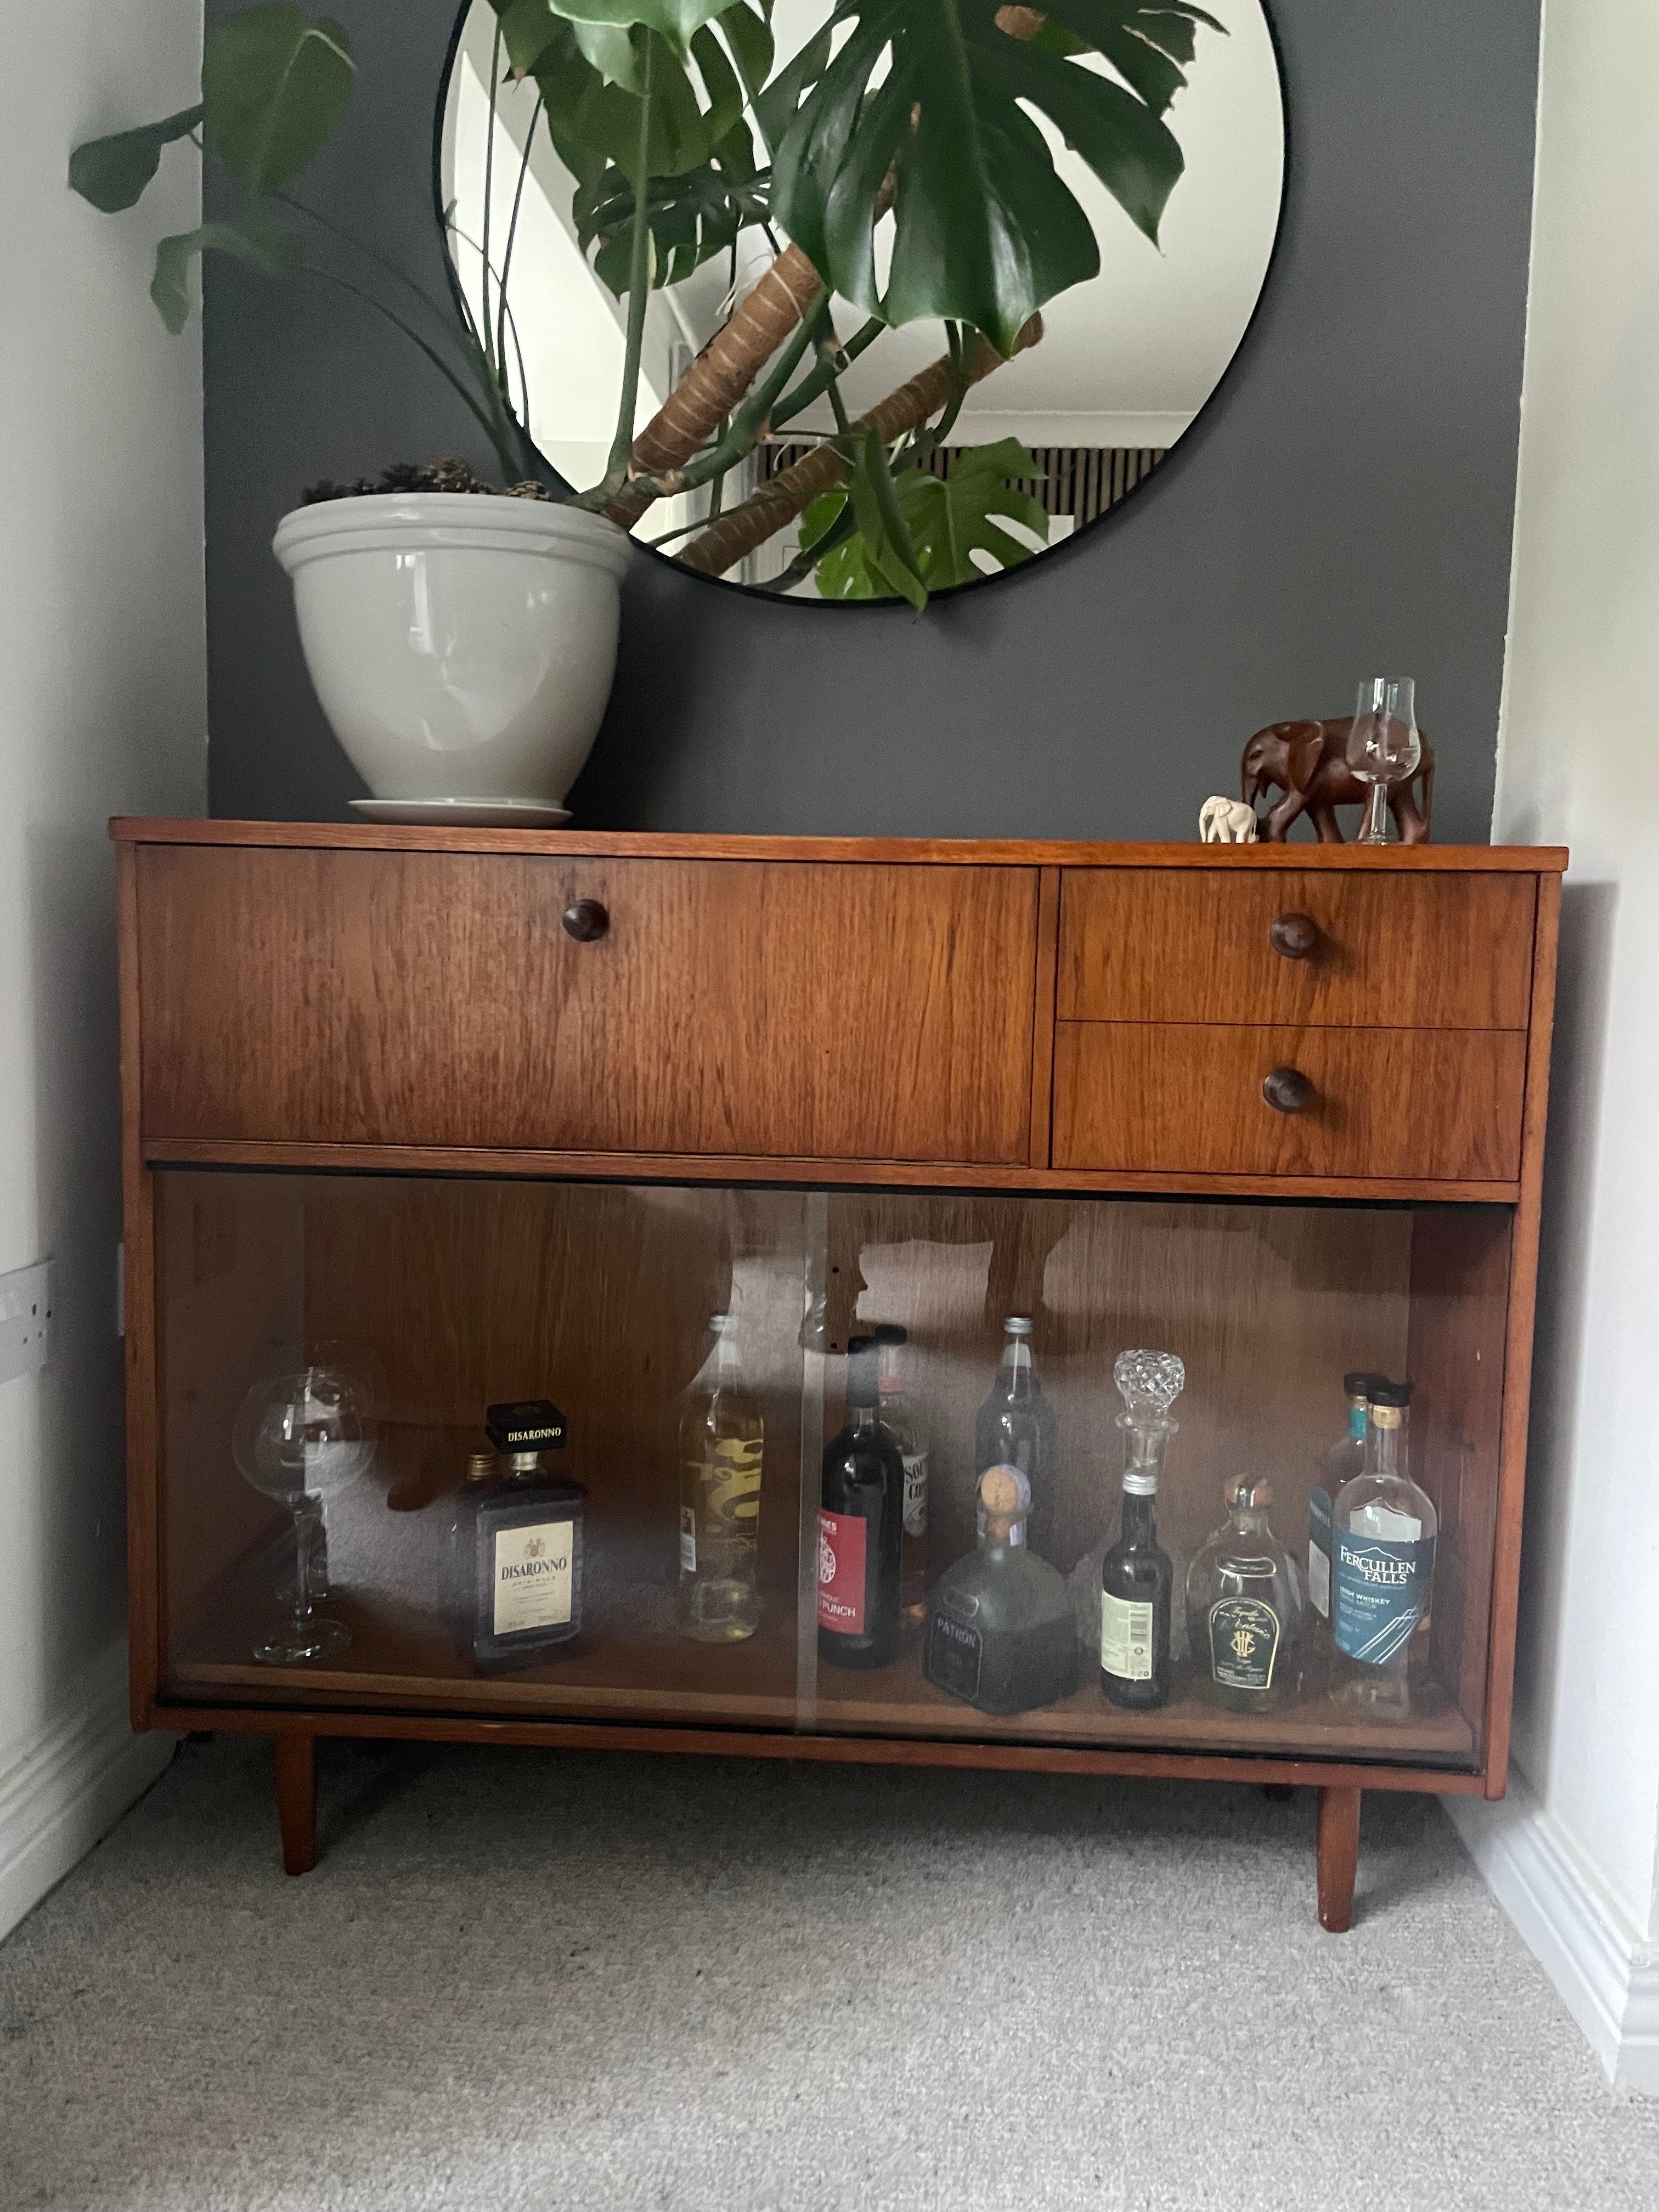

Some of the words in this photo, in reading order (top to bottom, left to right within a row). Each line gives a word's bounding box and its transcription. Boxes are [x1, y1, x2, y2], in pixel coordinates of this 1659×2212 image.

[508, 1427, 561, 1442] DISARONNO
[1341, 1545, 1415, 1574] FERCULLEN
[501, 1557, 567, 1580] DISARONNO
[1364, 1570, 1407, 1584] FALLS
[1356, 1593, 1390, 1605] WHISKEY
[822, 1600, 856, 1617] PUNCH
